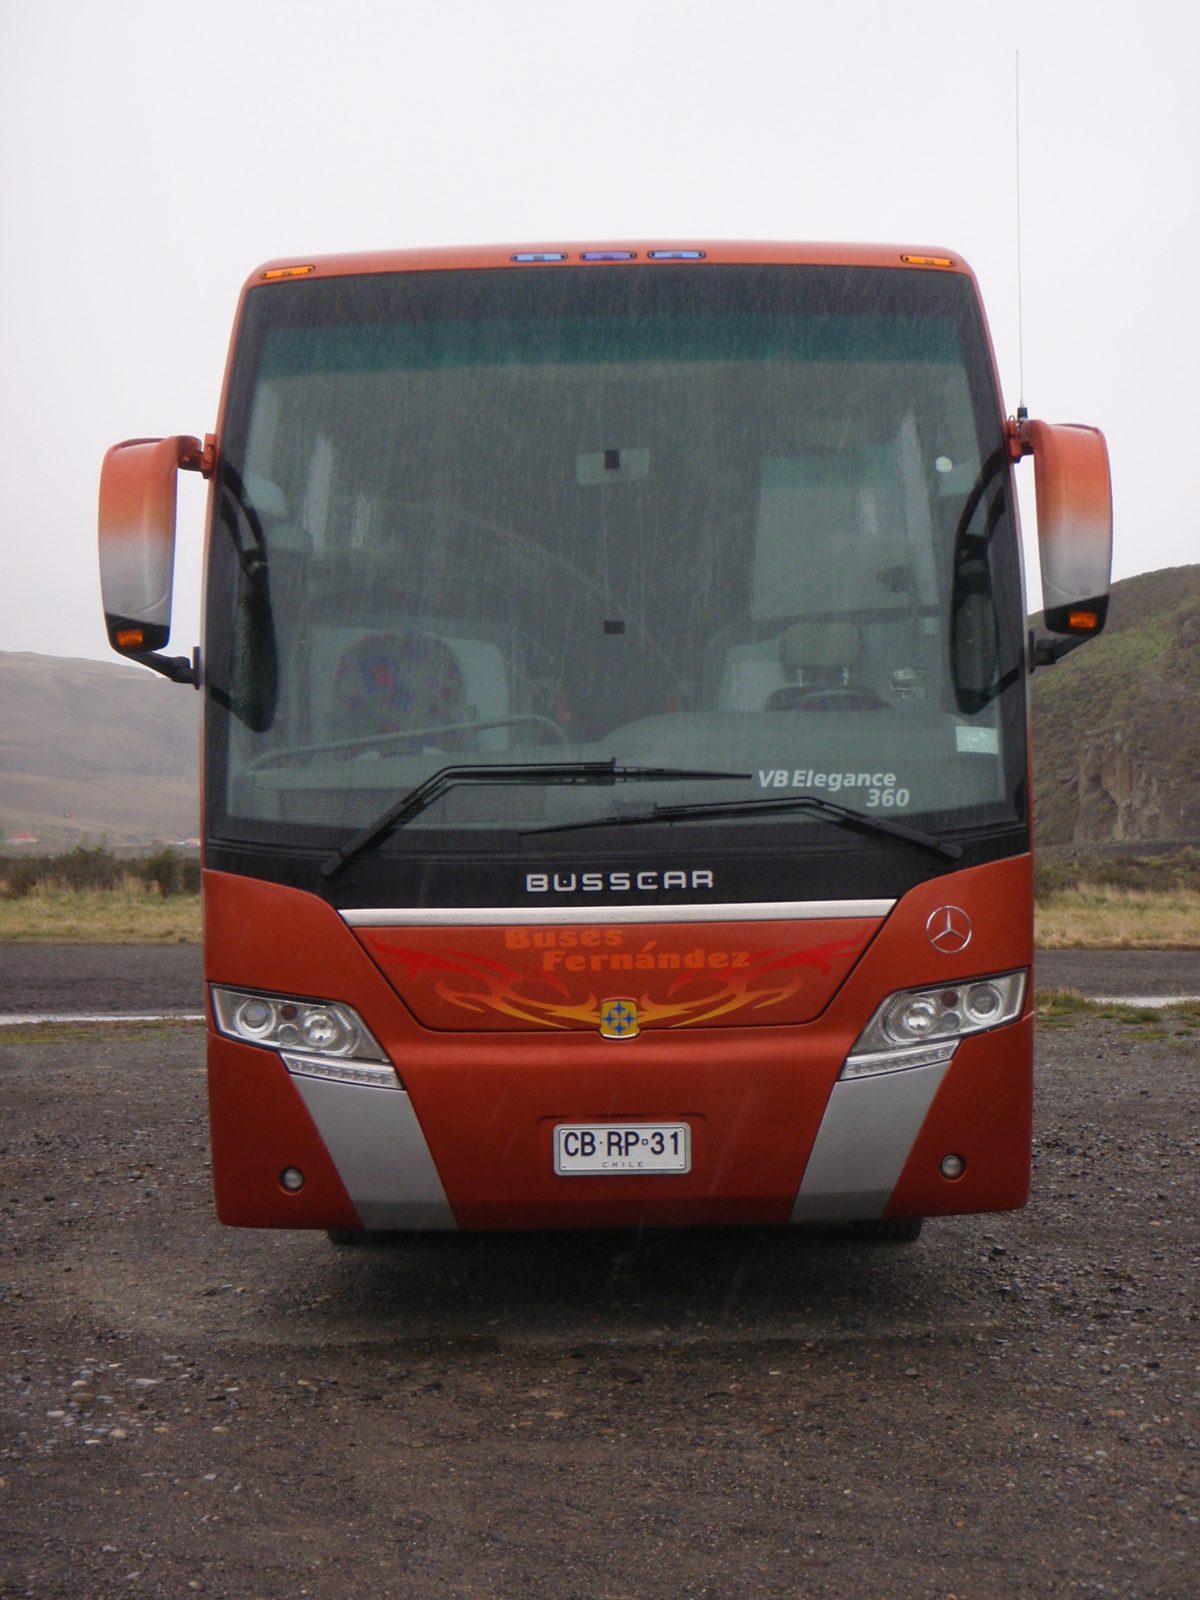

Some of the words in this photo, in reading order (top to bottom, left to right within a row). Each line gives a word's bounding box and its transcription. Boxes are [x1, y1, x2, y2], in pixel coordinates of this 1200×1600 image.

[758, 770, 788, 788] VB
[792, 769, 897, 791] Elegance
[866, 788, 910, 808] 360
[526, 870, 714, 892] BUSSCAR
[505, 927, 624, 950] Buses
[542, 941, 750, 971] Fernández
